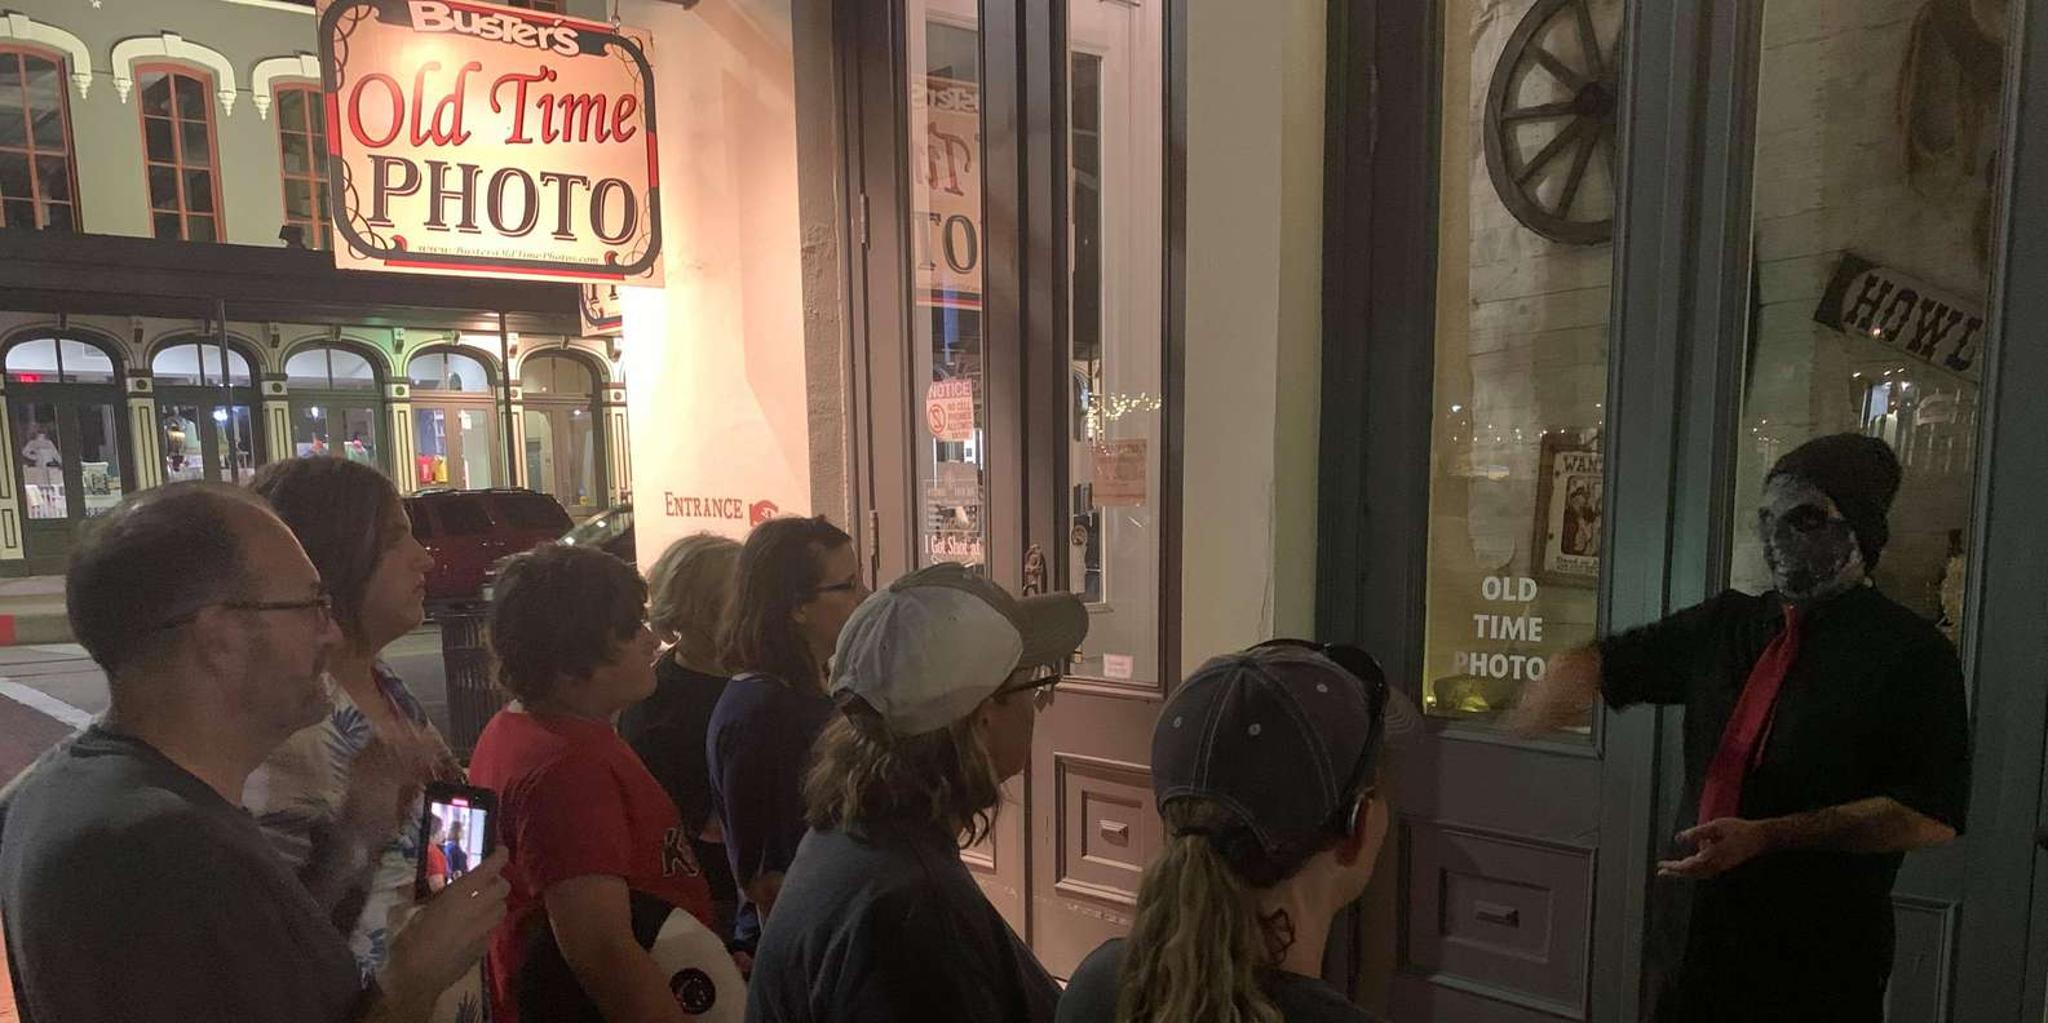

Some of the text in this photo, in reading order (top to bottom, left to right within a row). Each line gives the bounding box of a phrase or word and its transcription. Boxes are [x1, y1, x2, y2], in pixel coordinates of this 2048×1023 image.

[347, 61, 638, 148] Old Time
[367, 154, 640, 245] PHOTO
[928, 381, 970, 399] NOTICE
[664, 491, 744, 519] ENTRANCE
[931, 535, 946, 554] Got
[948, 535, 968, 554] Shot
[1482, 576, 1538, 602] OLD
[1473, 614, 1544, 642] TIME
